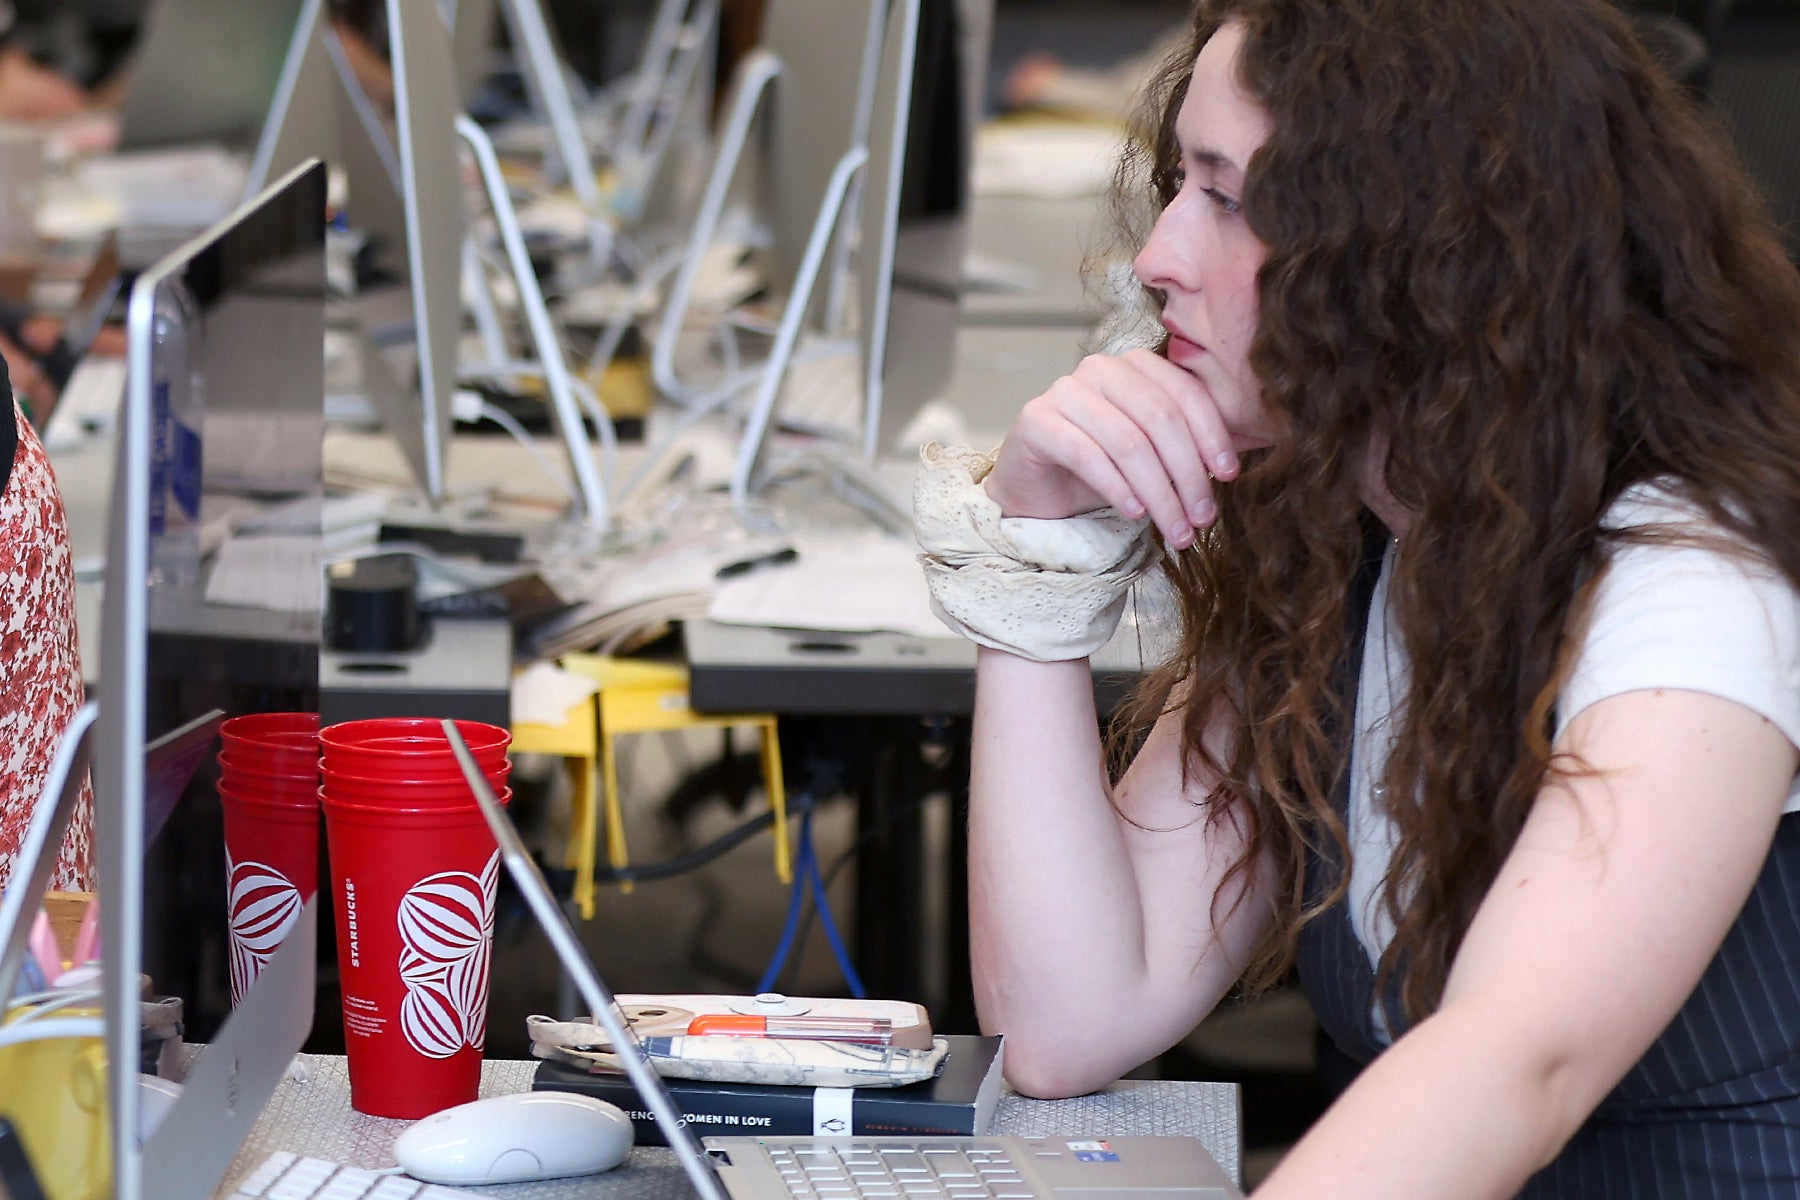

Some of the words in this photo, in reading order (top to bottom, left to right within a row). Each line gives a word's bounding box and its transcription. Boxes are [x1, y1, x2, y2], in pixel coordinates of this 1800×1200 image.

[345, 882, 360, 968] STARBUCKS
[624, 1110, 658, 1121] RENC
[682, 1113, 722, 1124] OMEN
[725, 1115, 739, 1125] IN
[742, 1116, 772, 1127] LOVE
